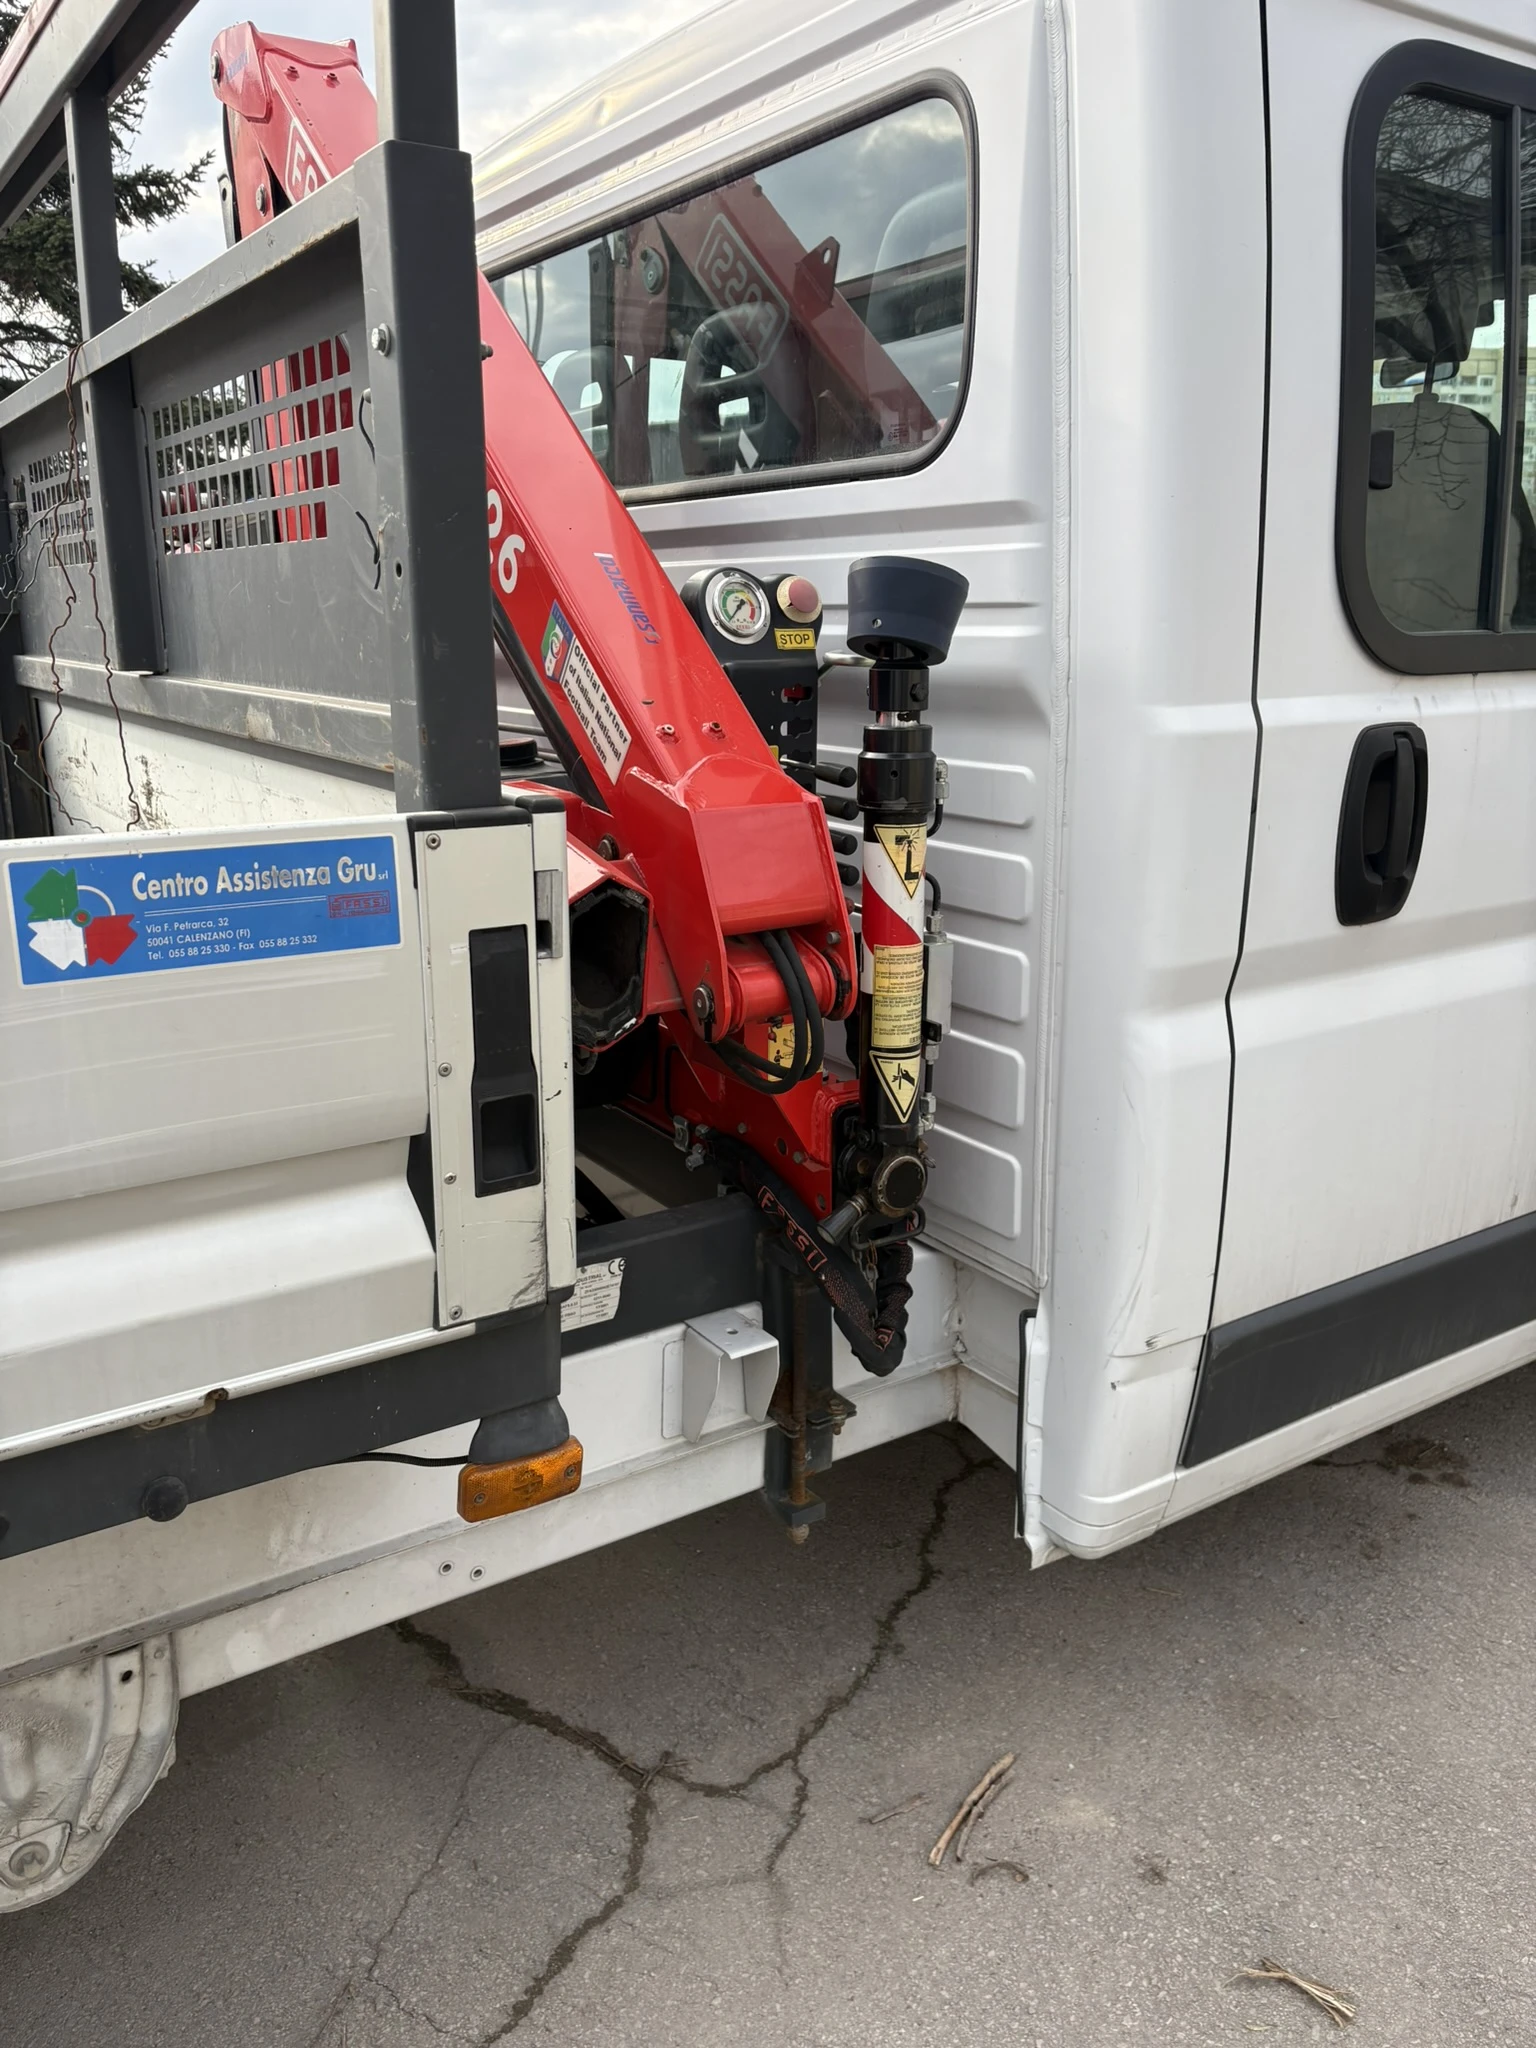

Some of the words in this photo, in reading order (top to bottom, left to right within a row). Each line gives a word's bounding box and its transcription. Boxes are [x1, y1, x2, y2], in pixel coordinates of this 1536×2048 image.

[780, 633, 810, 645] STOP
[568, 664, 577, 679] of
[575, 673, 595, 714] Italian
[594, 711, 622, 762] National
[574, 645, 600, 694] Official
[600, 693, 628, 744] Partner
[563, 679, 590, 730] Football
[589, 726, 608, 764] Team
[131, 871, 209, 901] Centro
[215, 861, 331, 894] Assistenza
[337, 856, 376, 884] Gru
[145, 923, 162, 934] Via
[164, 922, 173, 932] F.
[218, 917, 229, 927] 32
[147, 935, 173, 947] 50041
[176, 930, 234, 943] CALENZANO
[236, 928, 251, 939] (FI)
[148, 951, 164, 961] Tel.
[168, 948, 186, 958] 055
[187, 947, 199, 957] 88
[200, 945, 212, 955] 25
[213, 943, 230, 954] 330
[238, 941, 254, 951] Fax
[259, 938, 275, 948] 055
[277, 937, 288, 947] 88
[290, 935, 300, 945] 25
[302, 934, 318, 944] 332
[760, 1191, 818, 1266] FASSI
